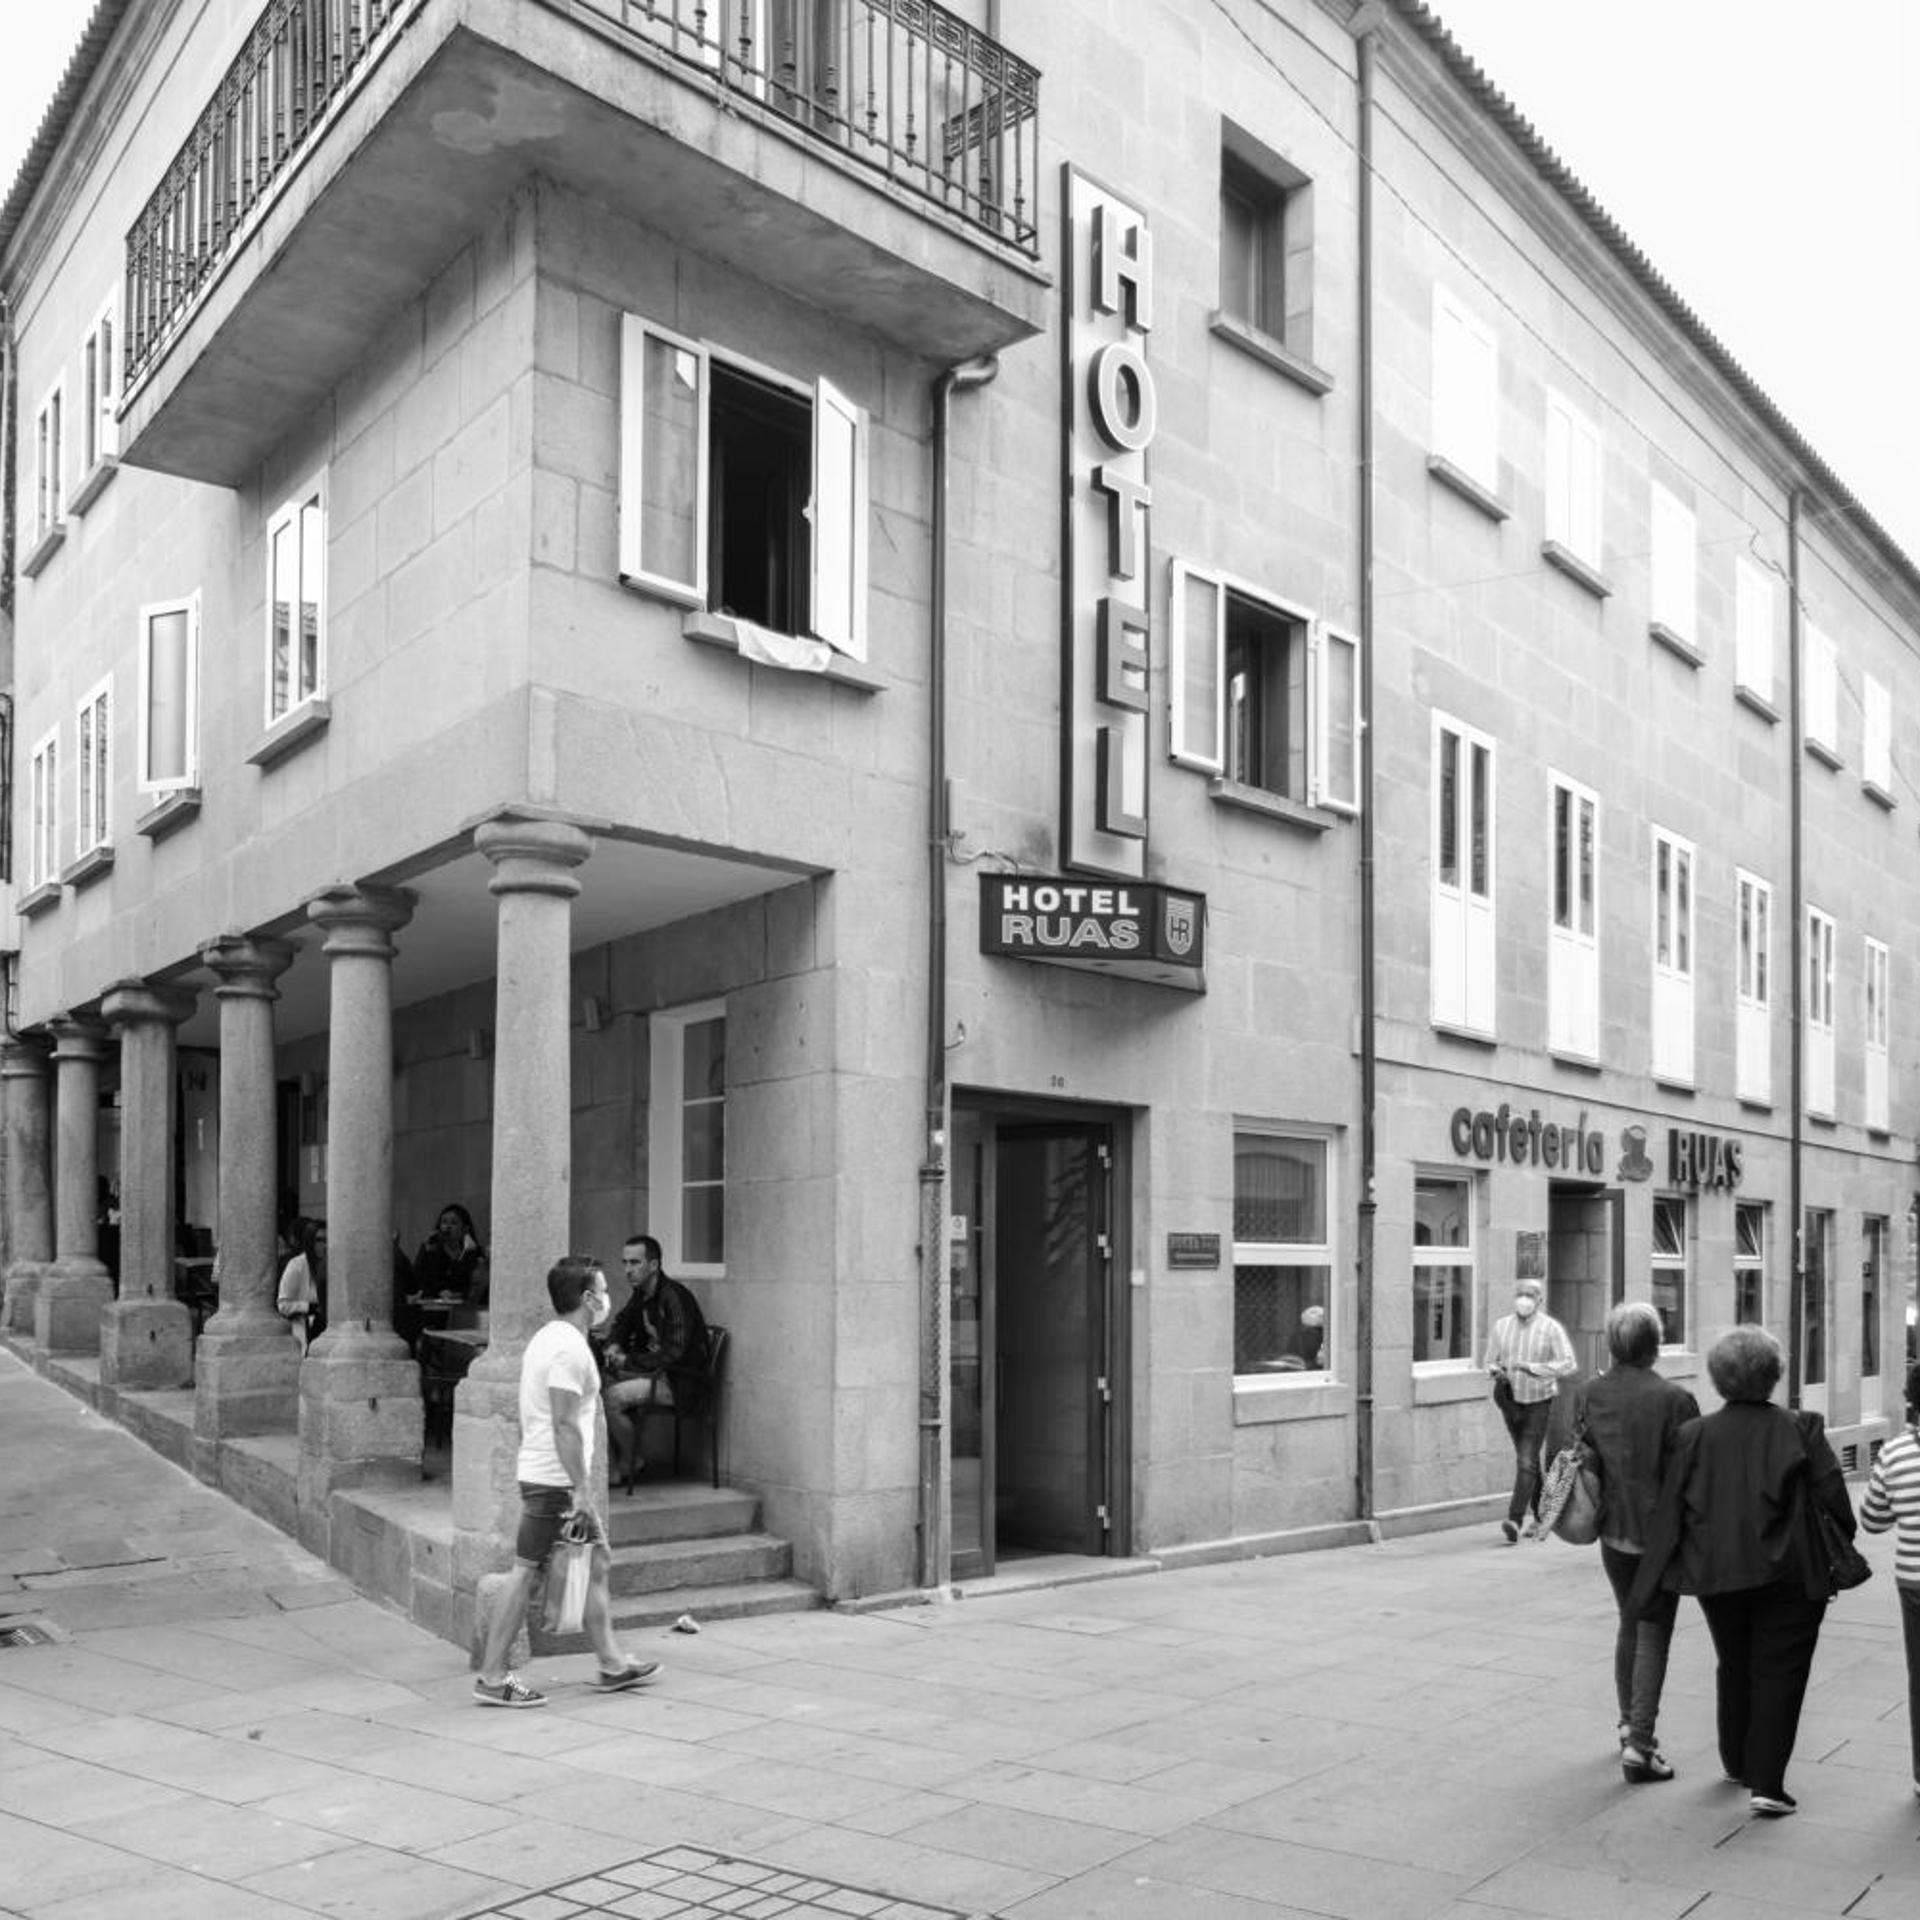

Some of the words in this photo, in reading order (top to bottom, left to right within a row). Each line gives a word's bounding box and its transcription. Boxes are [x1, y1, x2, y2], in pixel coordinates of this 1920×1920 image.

[1088, 203, 1157, 840] HOTEL
[1003, 884, 1140, 915] HOTEL
[1001, 914, 1140, 950] RUAS
[1668, 1128, 1745, 1187] RUAS
